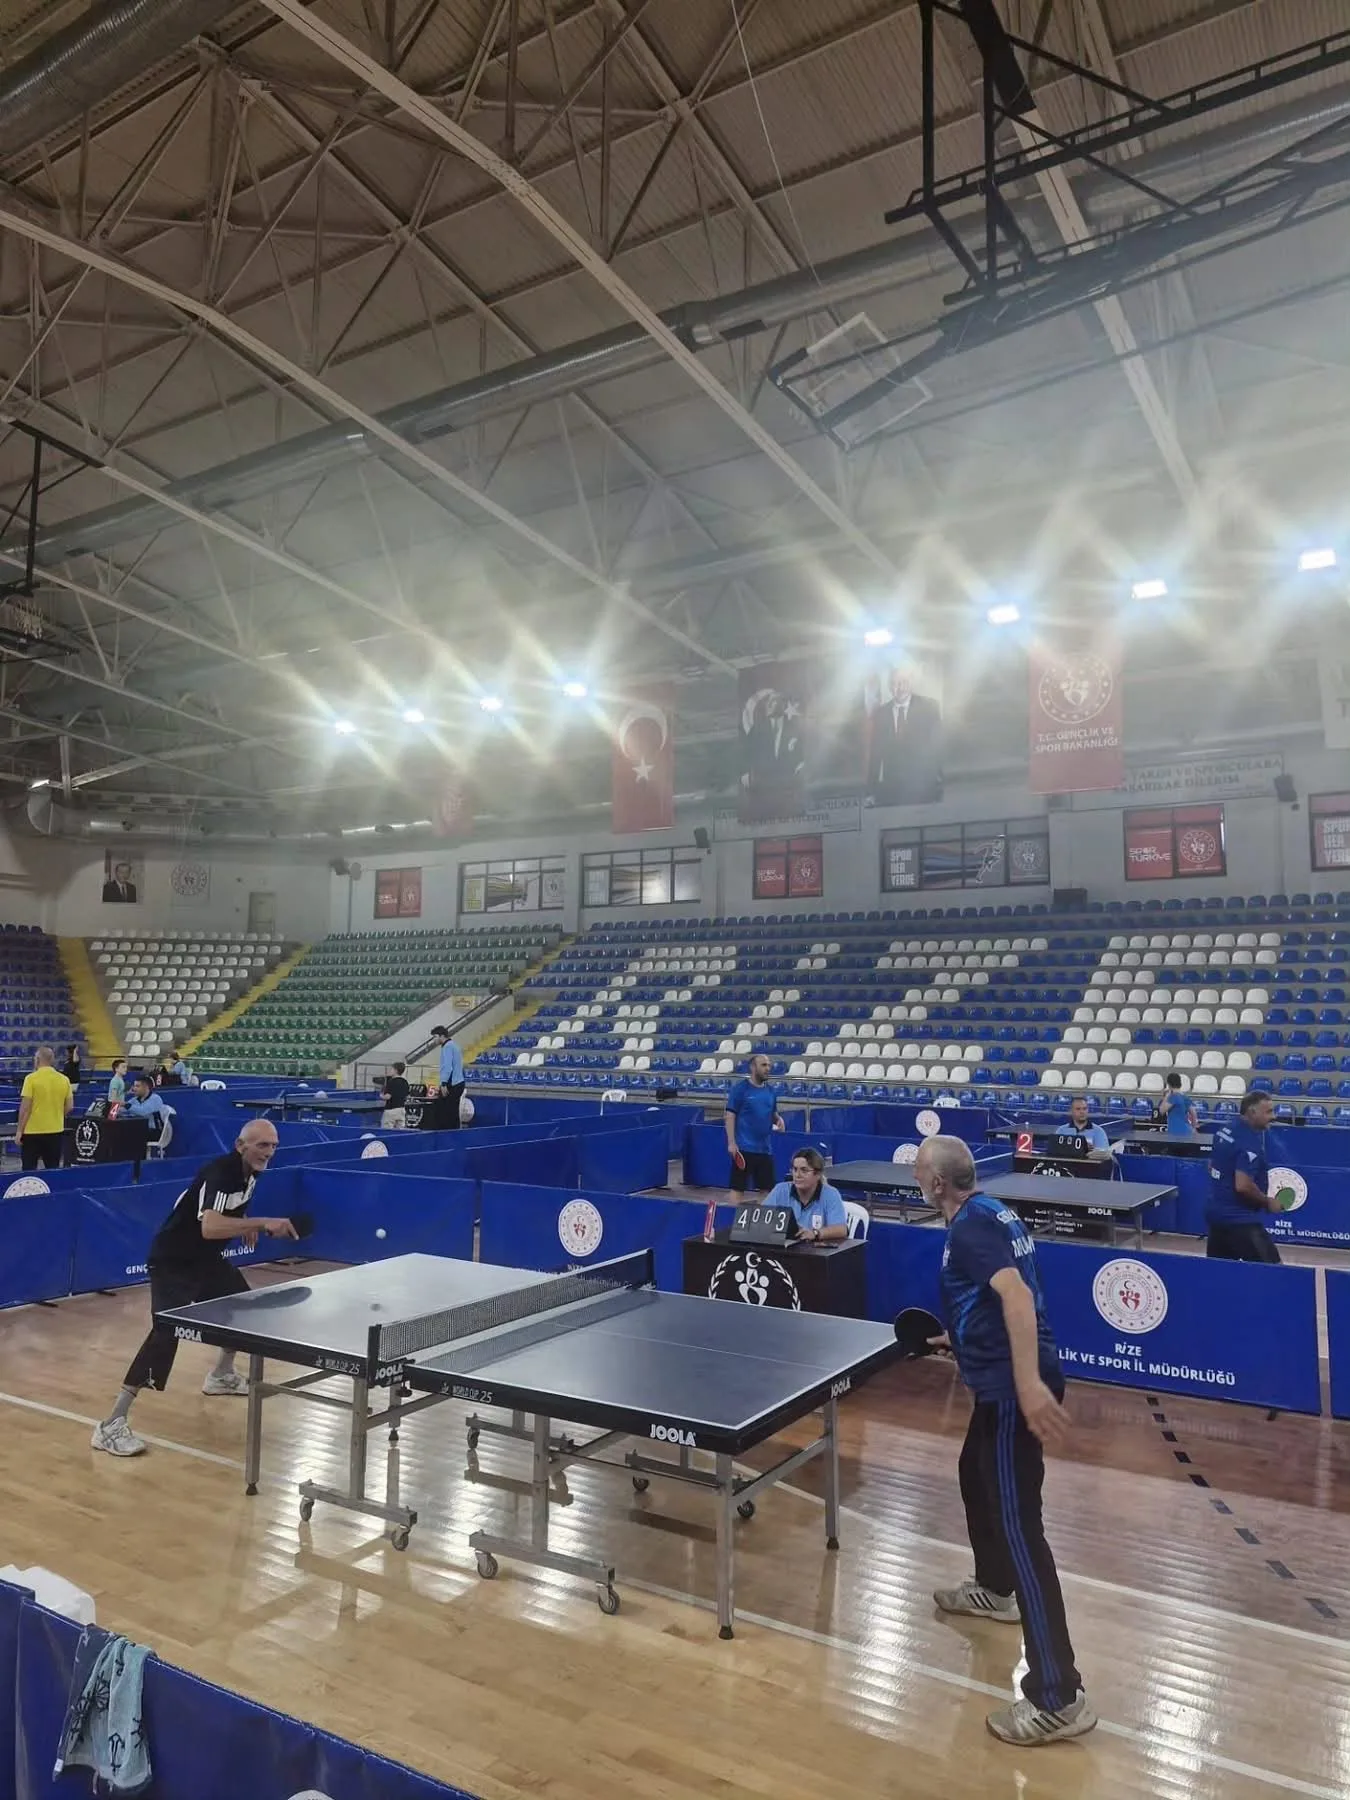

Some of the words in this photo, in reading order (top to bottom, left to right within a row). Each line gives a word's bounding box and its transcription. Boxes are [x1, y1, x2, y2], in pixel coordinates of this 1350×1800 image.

[110, 1103, 119, 1117] 4
[1018, 1133, 1031, 1152] 2
[1075, 1138, 1082, 1150] 0
[1087, 1206, 1113, 1216] JOOLA
[738, 1209, 748, 1229] 4
[752, 1208, 760, 1223] 0
[764, 1209, 773, 1225] 0
[775, 1211, 787, 1232] 3
[175, 1326, 202, 1342] JOOLA
[1114, 1341, 1142, 1357] RİZE
[349, 1363, 360, 1374] 25
[375, 1363, 403, 1380] JOOLA
[1081, 1353, 1096, 1365] VE
[1098, 1355, 1131, 1371] SPOR
[1134, 1359, 1146, 1373] İL
[1149, 1363, 1236, 1386] MÜDÜRLÜĞÜ
[830, 1377, 851, 1399] JOOLA
[480, 1391, 493, 1403] 25
[650, 1424, 696, 1447] JOOLA
